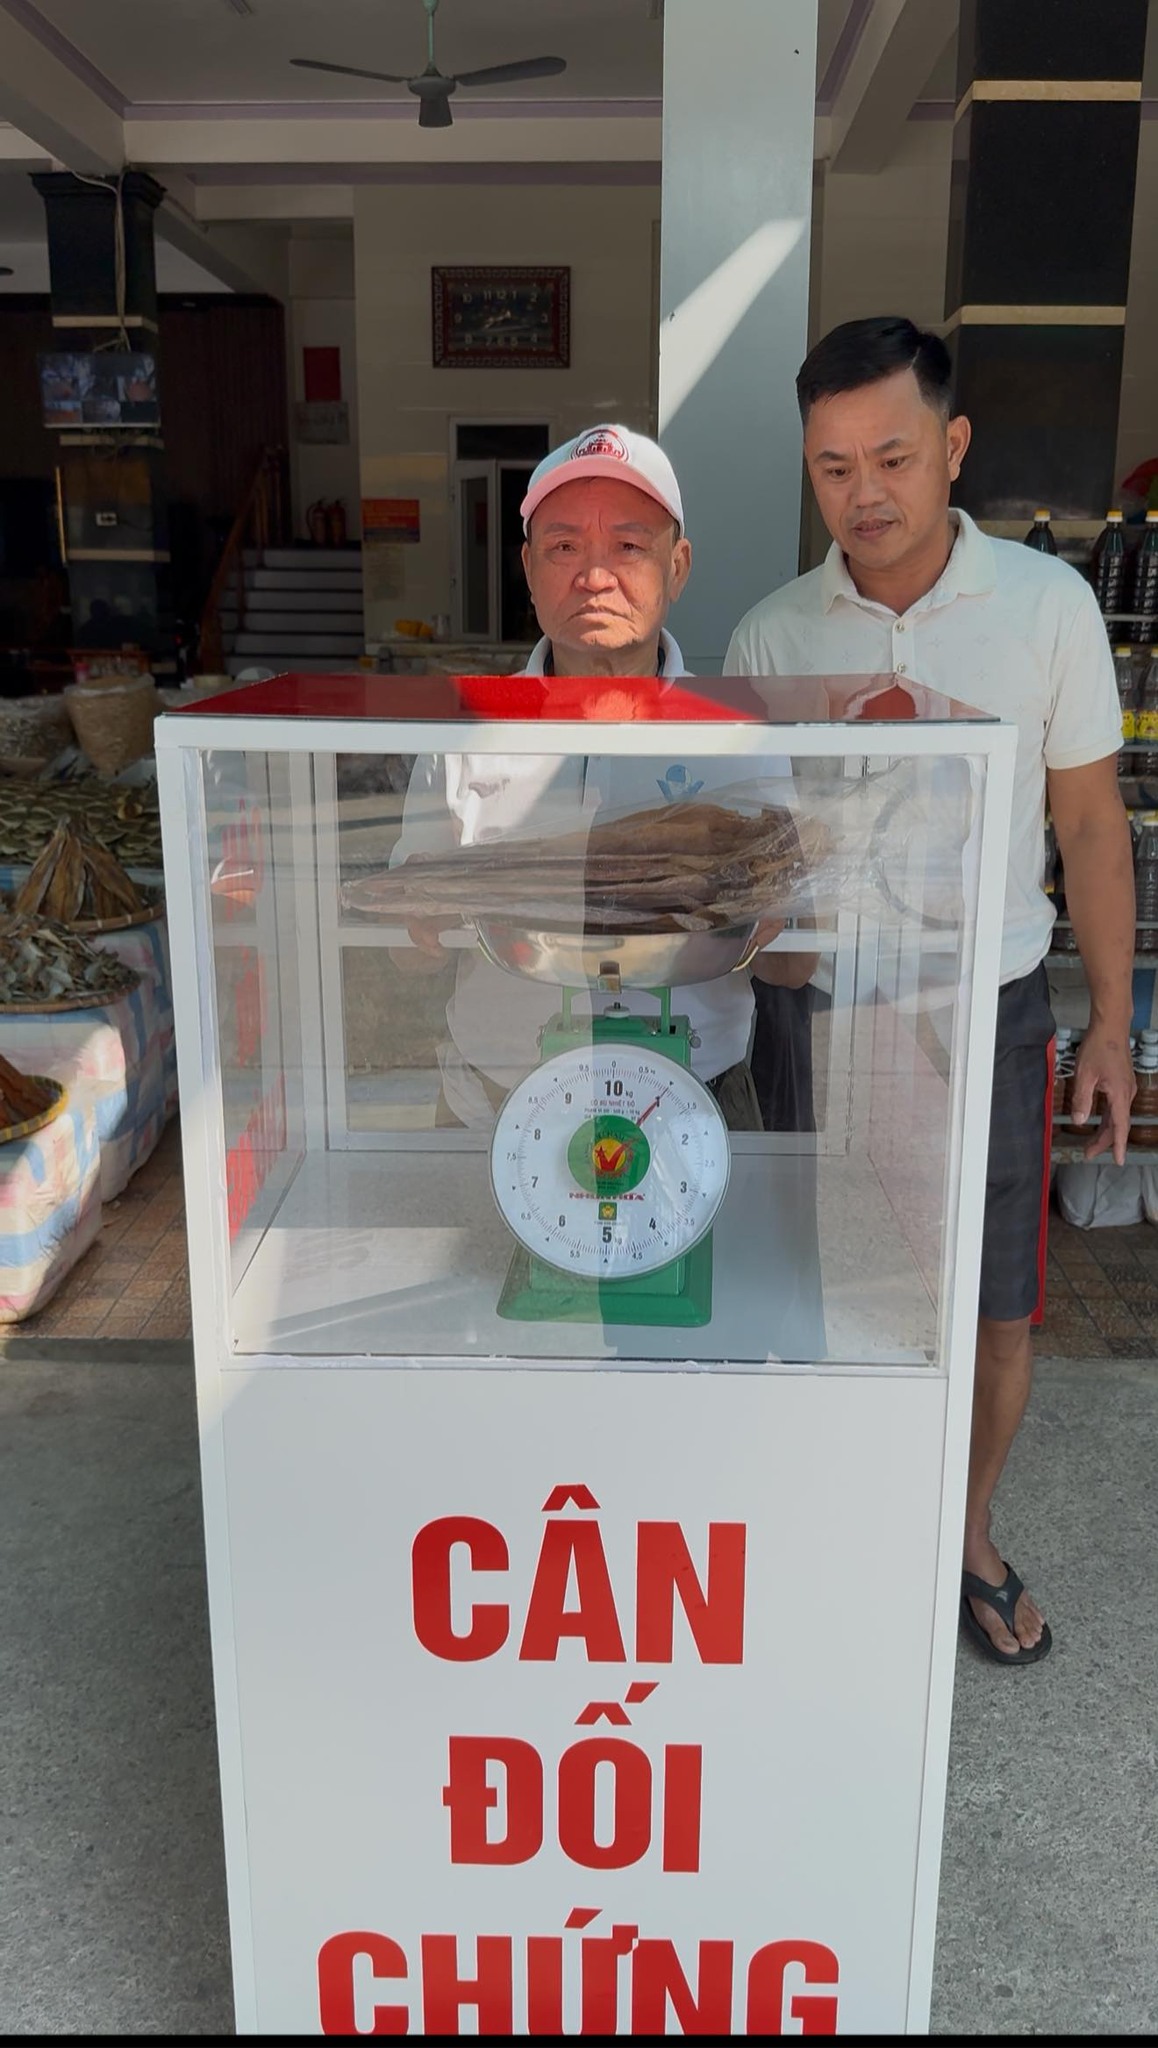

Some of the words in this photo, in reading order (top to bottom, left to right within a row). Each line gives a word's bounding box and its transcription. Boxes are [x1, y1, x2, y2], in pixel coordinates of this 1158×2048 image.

[612, 1060, 616, 1068] 0
[604, 1080, 624, 1096] 10
[565, 1092, 572, 1104] 9
[655, 1096, 660, 1108] 1
[534, 1128, 542, 1140] 8
[681, 1133, 689, 1146] 2
[532, 1176, 538, 1188] 7
[680, 1180, 688, 1194] 3
[558, 1214, 566, 1228] 6
[648, 1217, 656, 1230] 4
[602, 1226, 612, 1243] 5
[412, 1484, 747, 1665] CÂN
[443, 1682, 703, 1873] ĐỐI
[318, 1908, 840, 2036] CHỨNG
